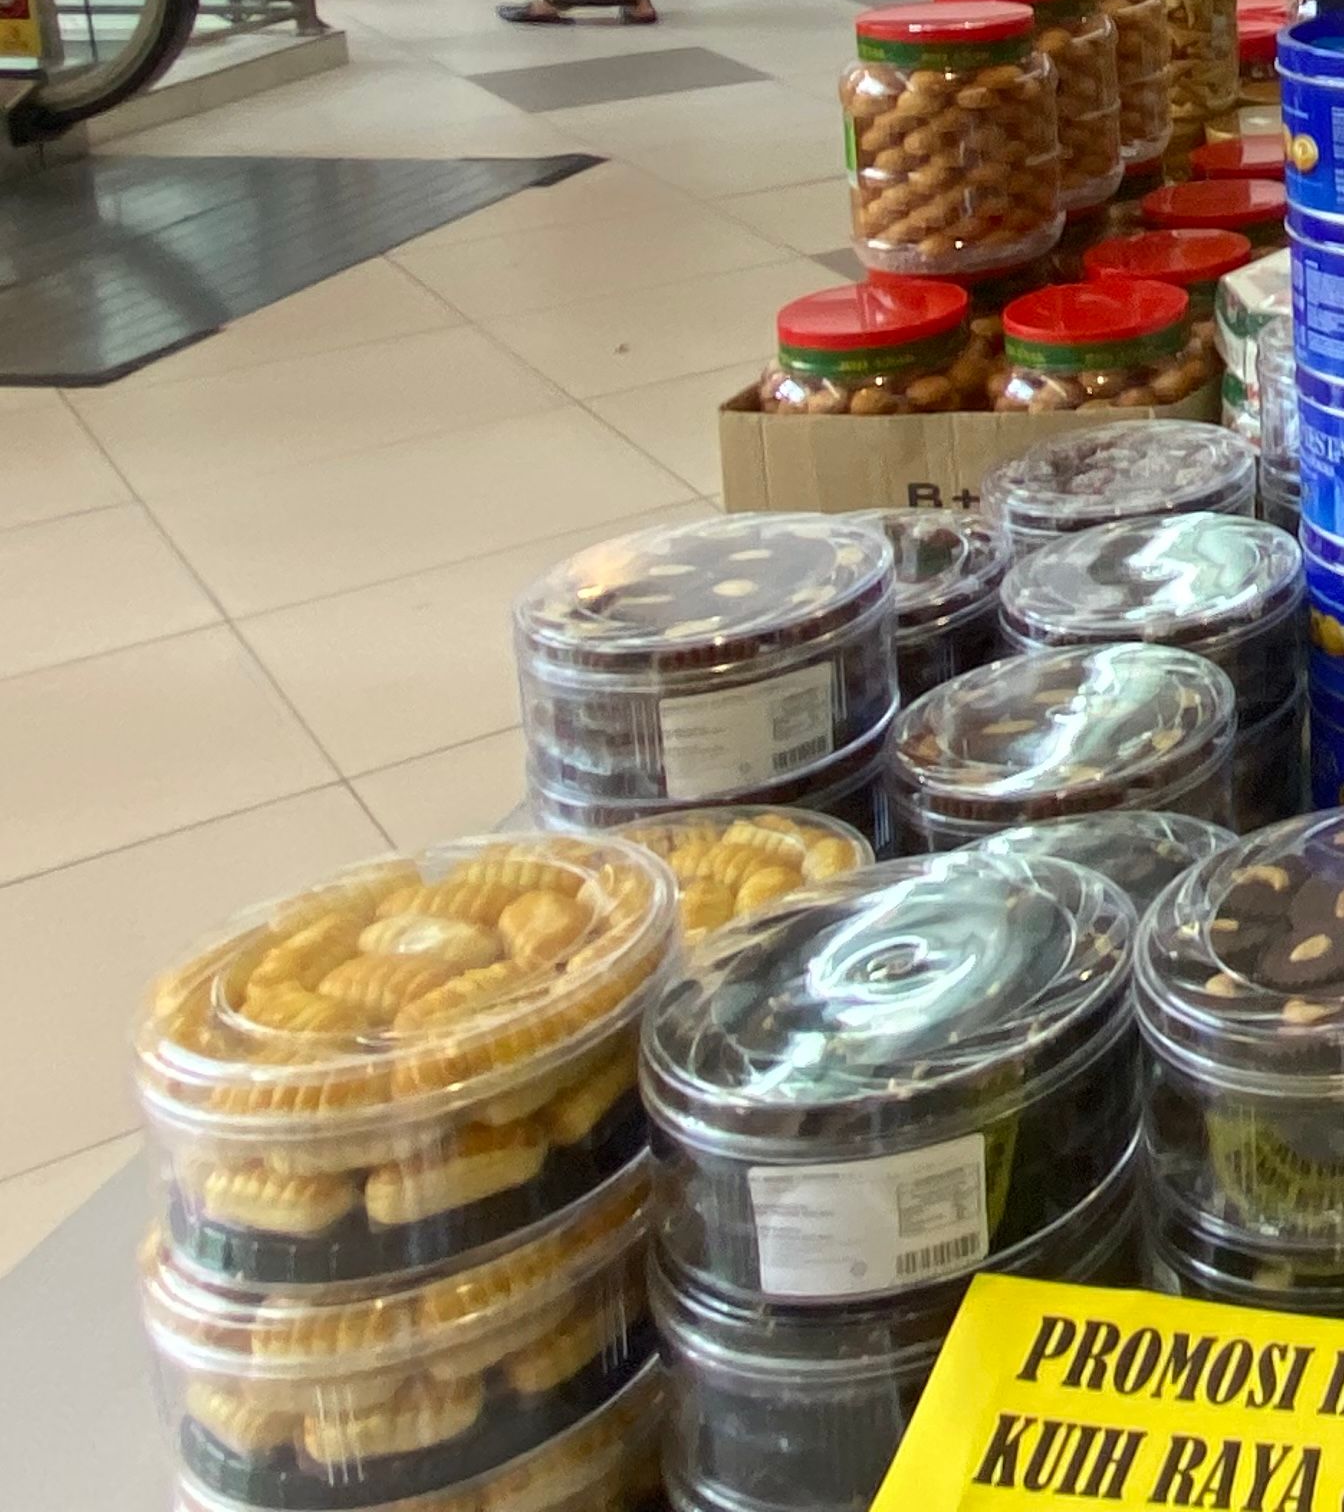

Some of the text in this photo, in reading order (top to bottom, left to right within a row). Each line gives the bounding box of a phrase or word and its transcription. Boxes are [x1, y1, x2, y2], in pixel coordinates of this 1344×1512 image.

[1016, 1315, 1315, 1412] PROMOSI
[972, 1412, 1147, 1500] KUIH
[1147, 1434, 1322, 1512] RAYA
